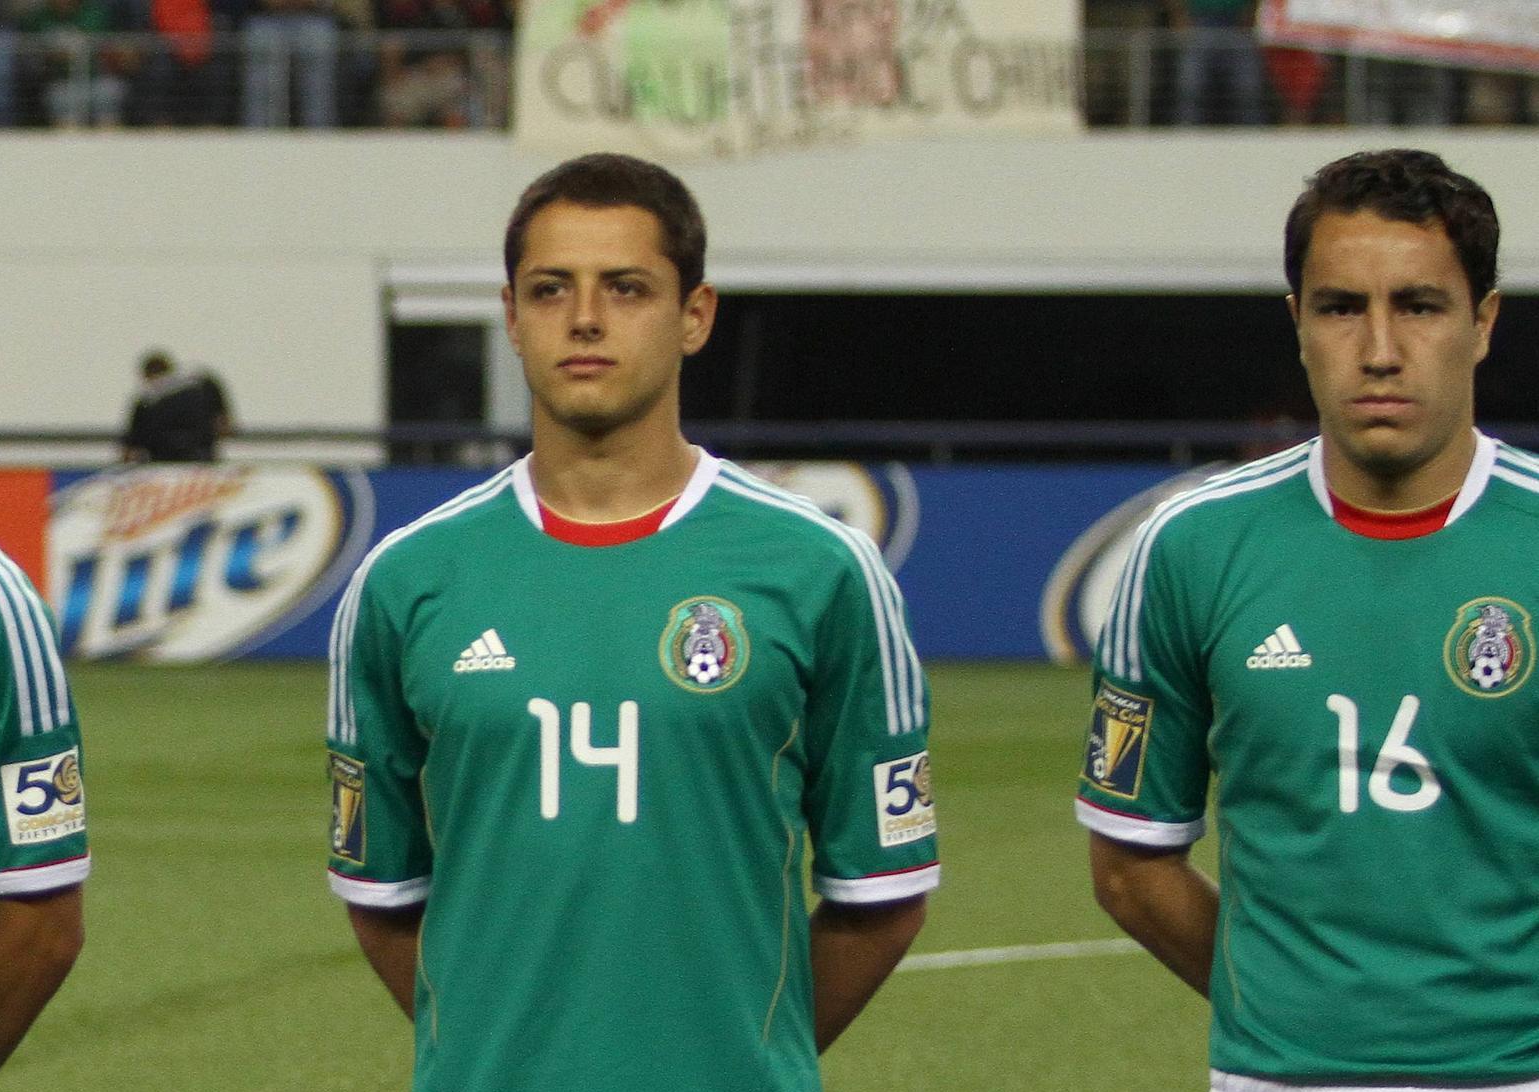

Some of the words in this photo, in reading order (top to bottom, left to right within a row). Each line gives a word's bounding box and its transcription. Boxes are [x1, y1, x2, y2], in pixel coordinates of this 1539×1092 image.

[453, 655, 516, 672] adidas
[1246, 652, 1312, 669] adidas
[528, 698, 638, 823] 14
[1326, 694, 1441, 813] 16
